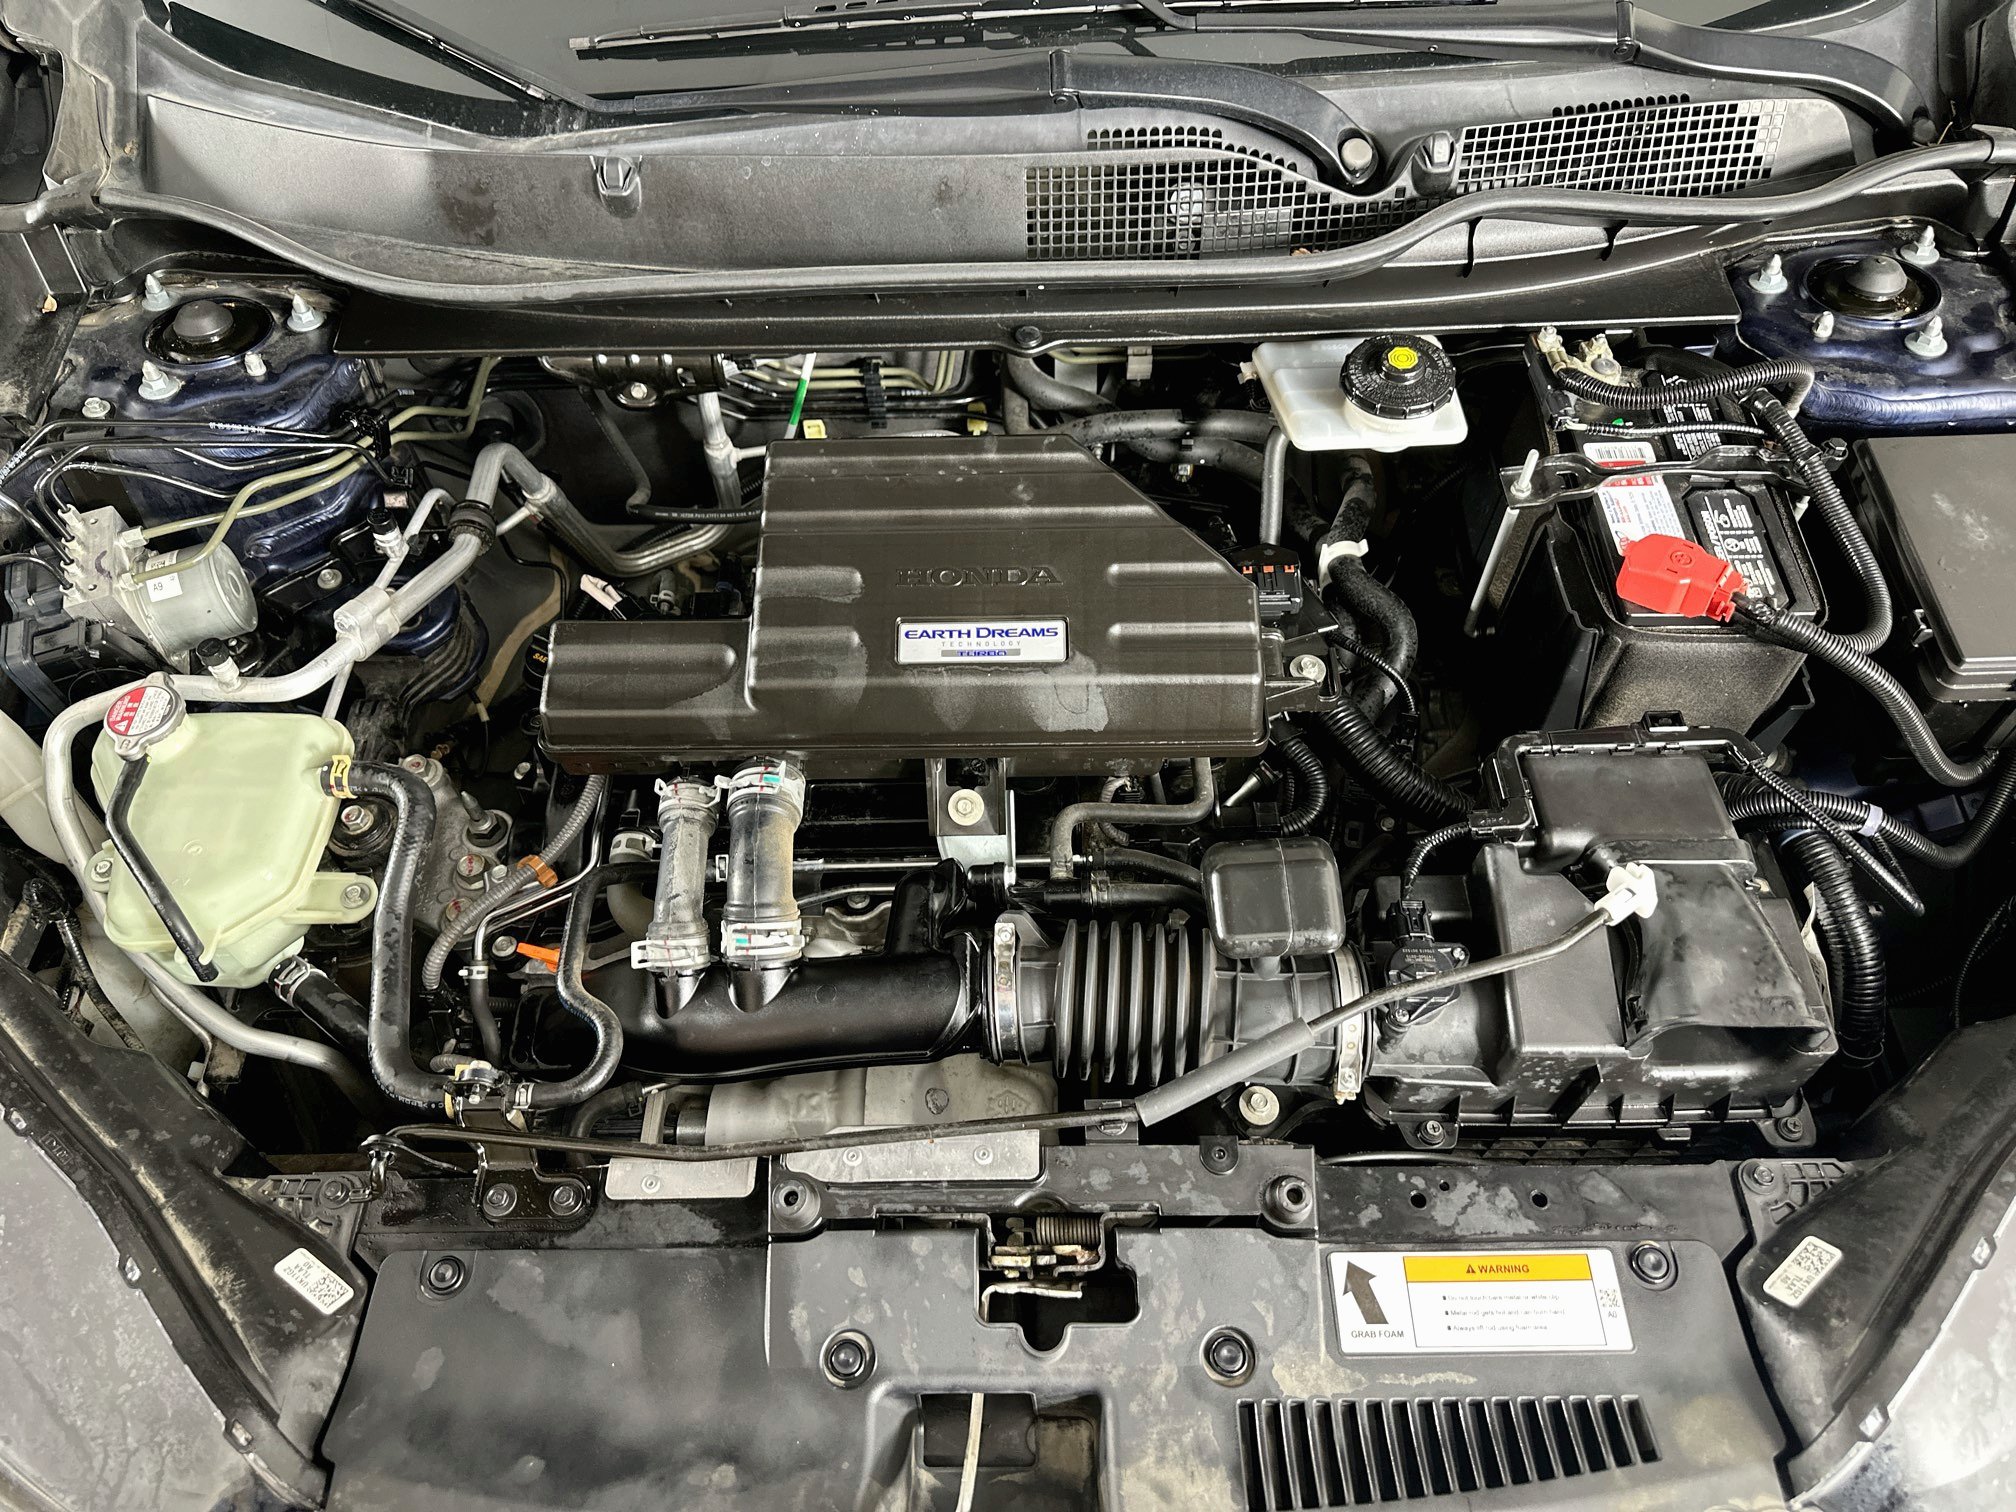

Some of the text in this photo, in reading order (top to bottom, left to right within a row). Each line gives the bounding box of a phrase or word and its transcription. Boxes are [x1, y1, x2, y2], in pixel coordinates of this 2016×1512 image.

[896, 567, 1063, 586] HONDA
[904, 627, 1058, 639] EARTH DREAMS
[957, 649, 1007, 657] TURBO
[1478, 1264, 1530, 1274] WARNING
[1350, 1330, 1405, 1339] GRAB FOAM
